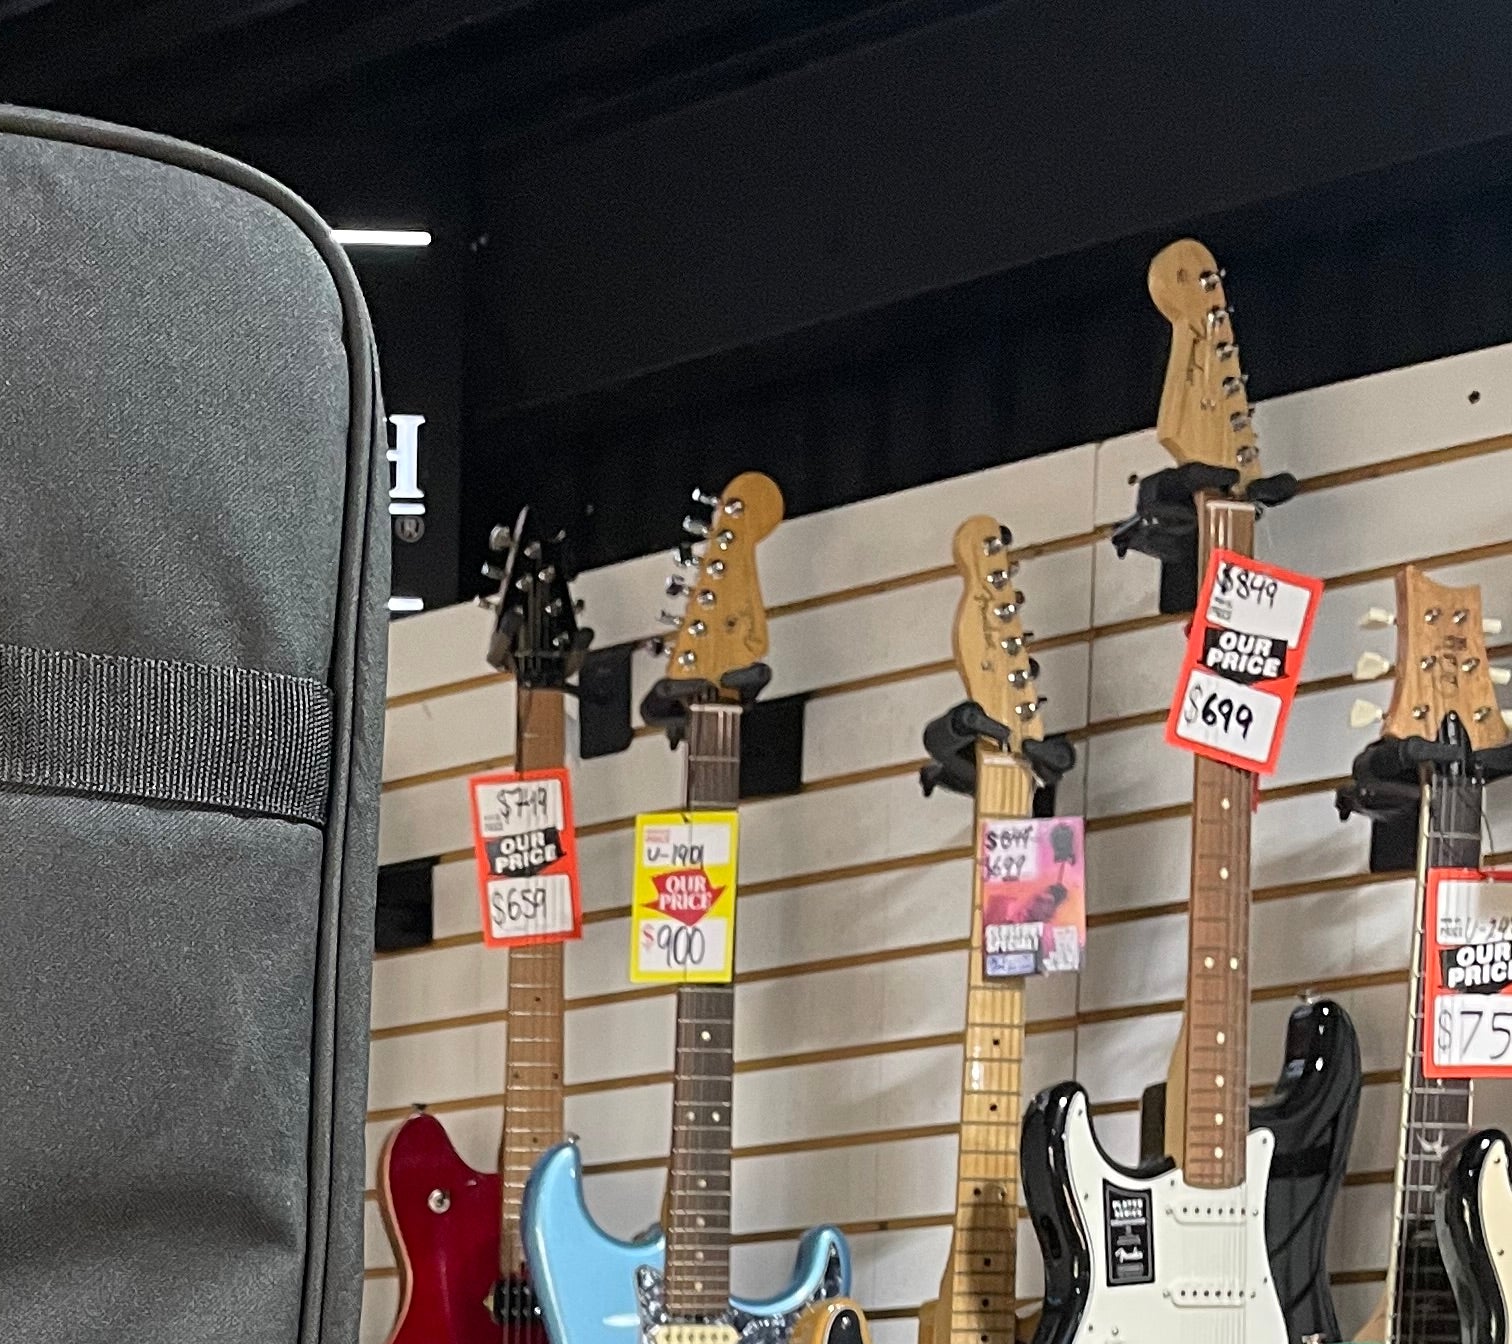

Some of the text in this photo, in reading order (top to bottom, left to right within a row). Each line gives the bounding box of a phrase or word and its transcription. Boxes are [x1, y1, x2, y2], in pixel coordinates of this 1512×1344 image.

[1216, 562, 1278, 609] $849
[1219, 631, 1273, 657] OUR
[1206, 647, 1282, 678] PRICE
[1183, 683, 1254, 740] $699
[499, 831, 546, 855] OUR
[494, 844, 558, 874] PRICE
[664, 875, 707, 895] OUR
[659, 893, 713, 911] PRICE
[642, 924, 706, 968] $900
[1456, 942, 1511, 968] OUR
[1447, 961, 1512, 989] PRIC
